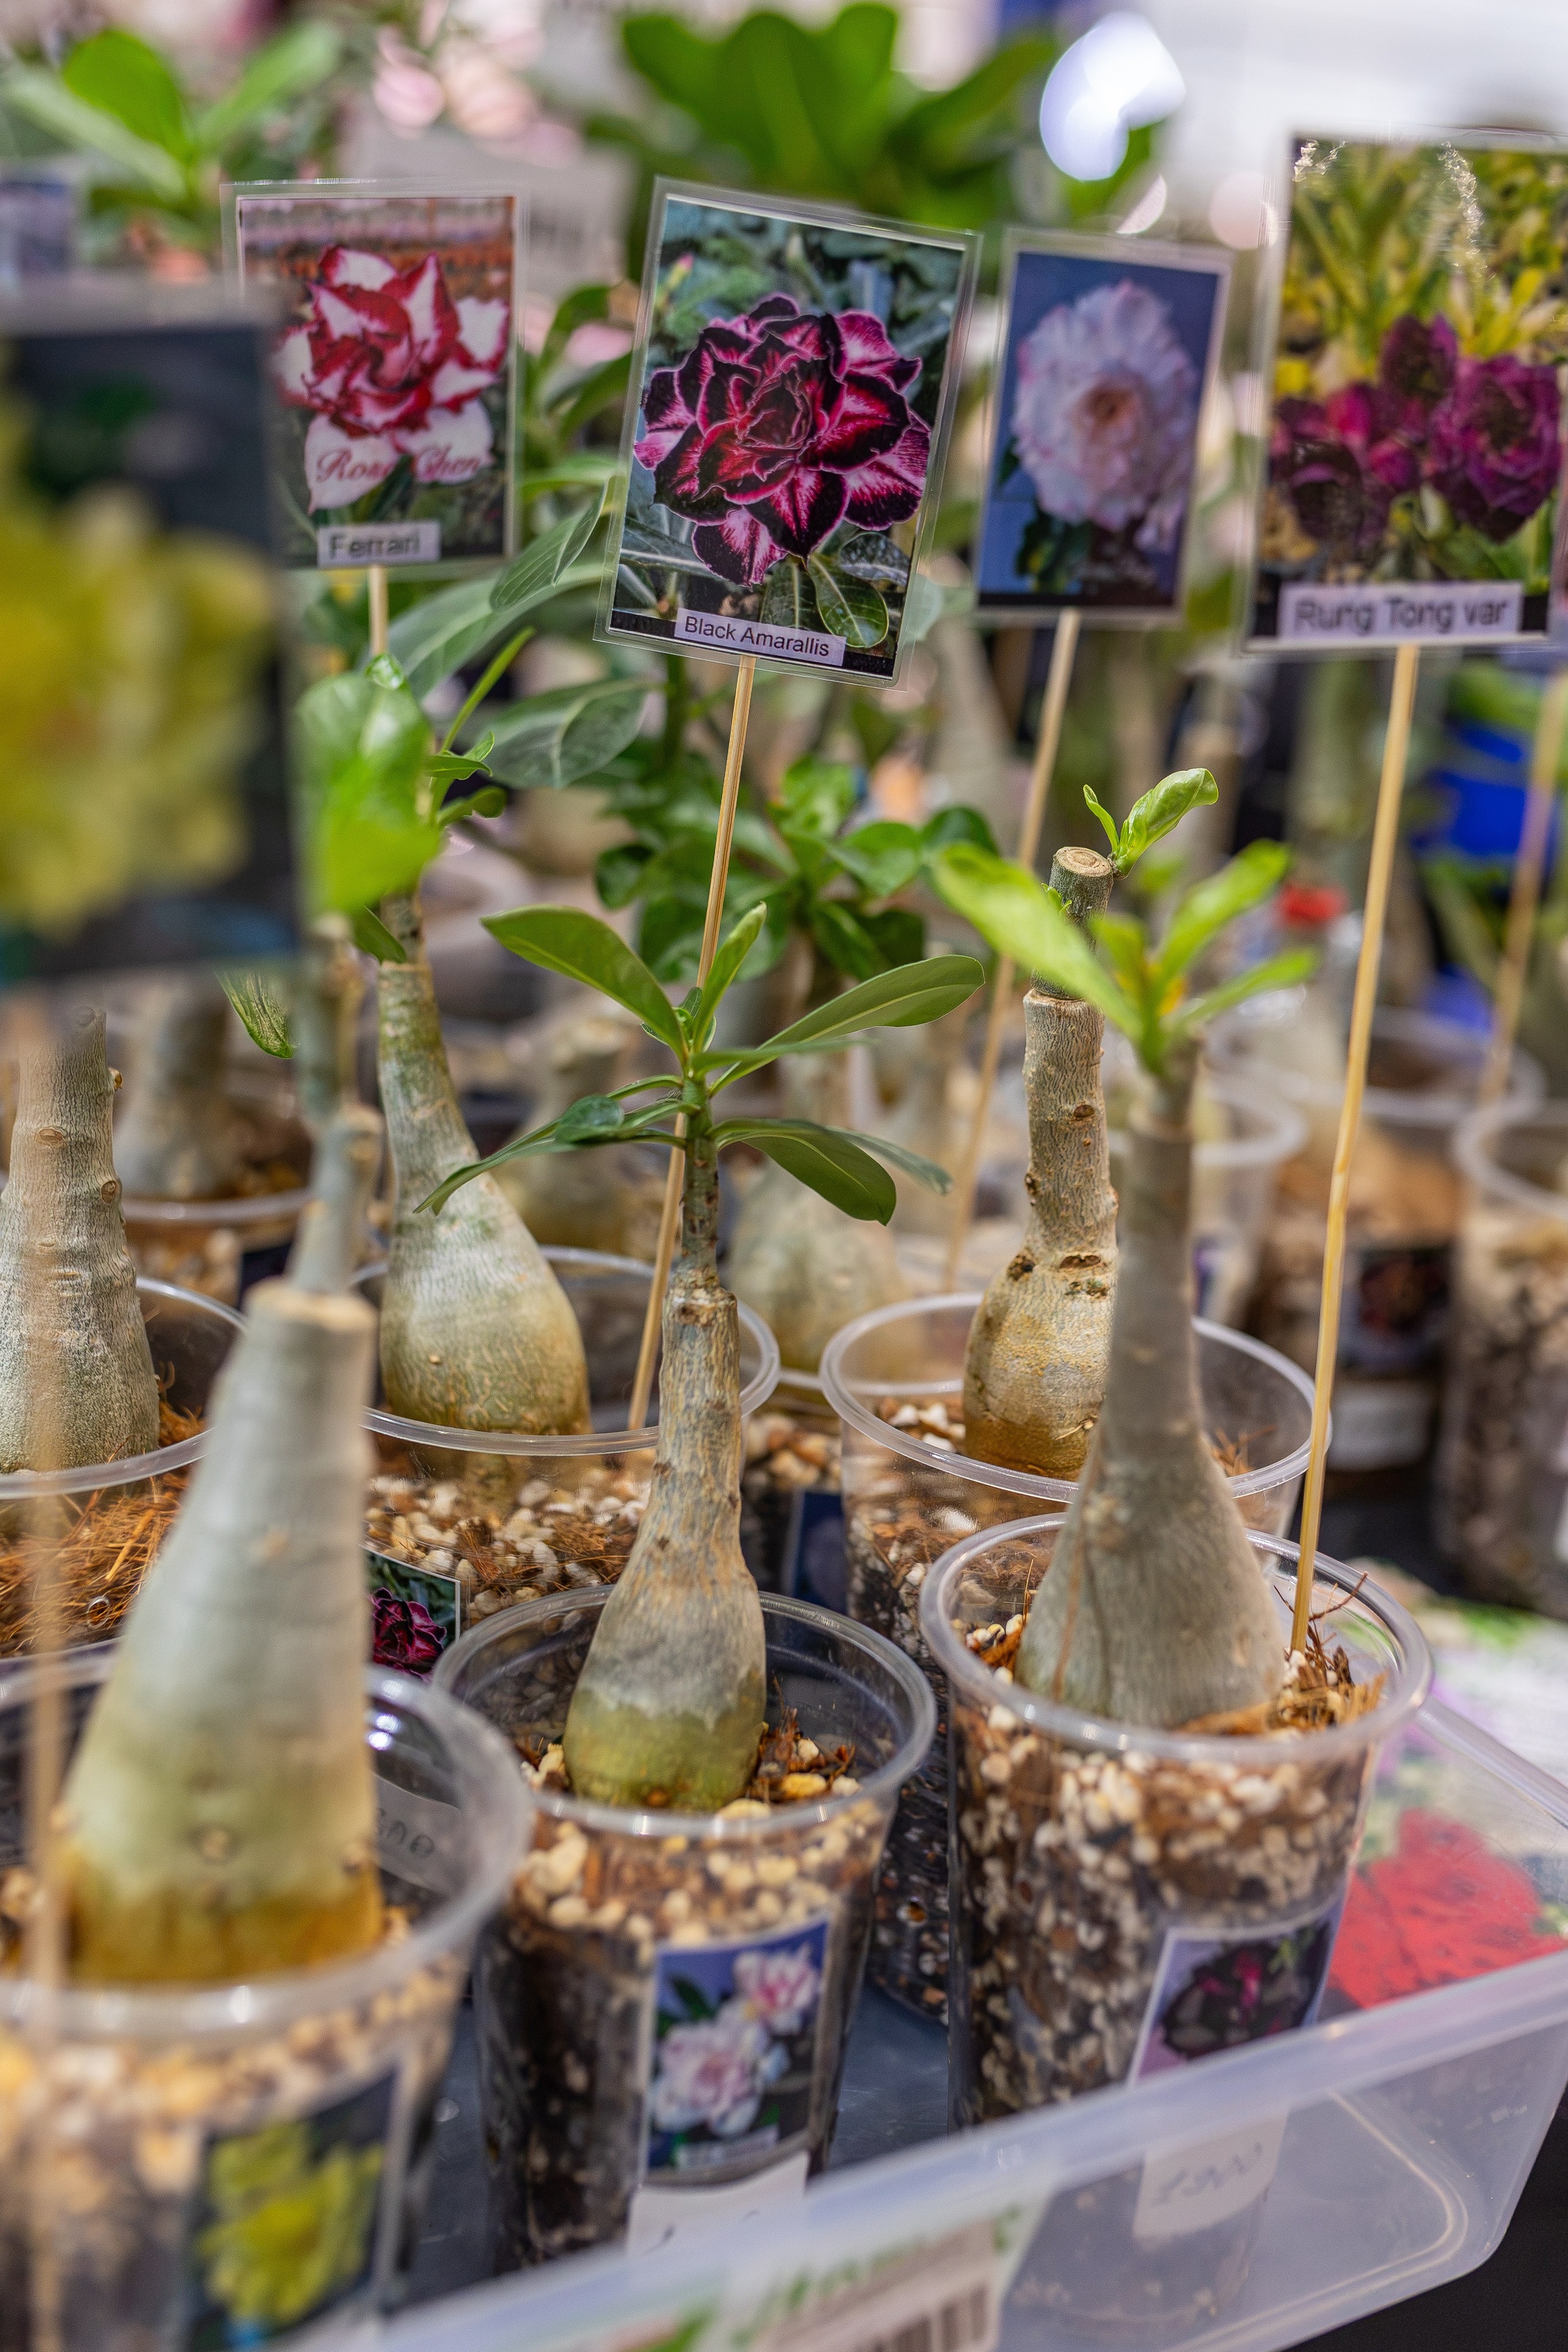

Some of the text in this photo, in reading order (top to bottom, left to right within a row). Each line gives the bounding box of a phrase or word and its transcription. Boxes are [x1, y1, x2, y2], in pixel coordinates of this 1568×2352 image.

[330, 528, 421, 559] Ferrari
[1293, 595, 1507, 636] Rung Tong var
[684, 616, 829, 657] Black Amarallis
